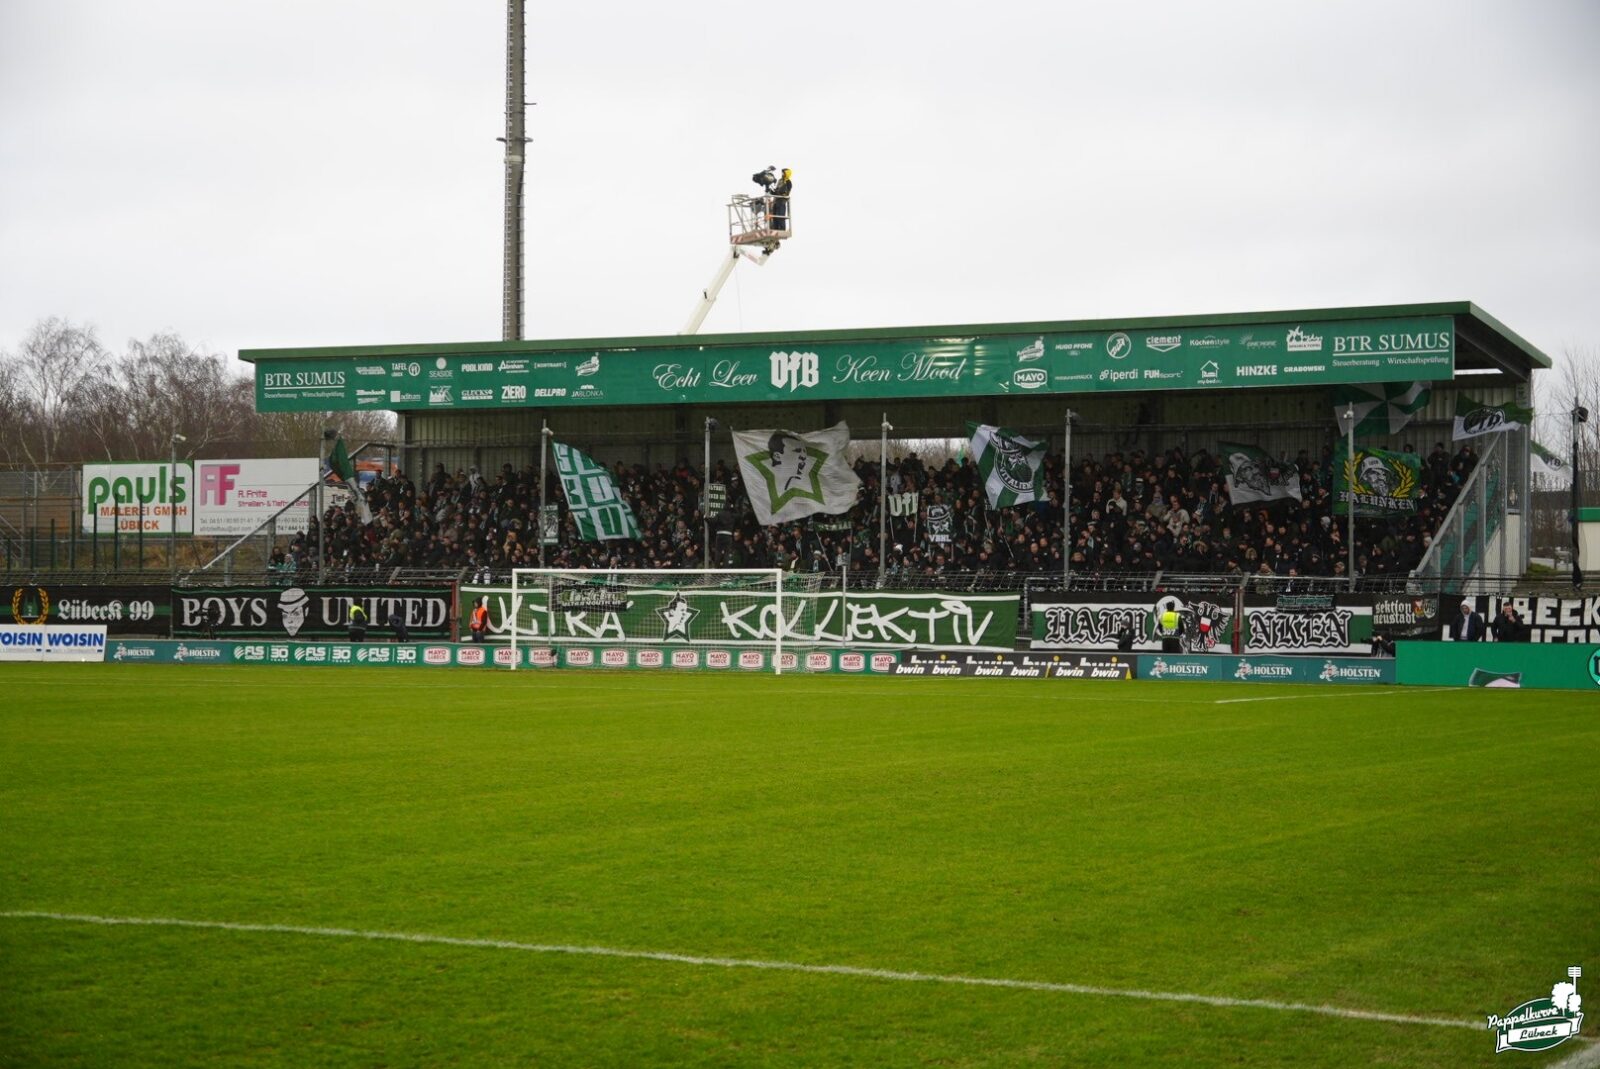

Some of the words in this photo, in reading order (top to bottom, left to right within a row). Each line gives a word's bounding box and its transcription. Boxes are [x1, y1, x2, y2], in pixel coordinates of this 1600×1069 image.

[1333, 336, 1371, 352] BTR
[1378, 332, 1450, 350] SUMUS
[833, 354, 891, 383] Keen
[897, 352, 967, 382] Mood
[1237, 365, 1277, 376] HINZKE
[264, 373, 292, 387] BTR
[296, 371, 345, 386] SUMUS
[653, 363, 701, 390] Echt
[1017, 373, 1044, 382] MAYO
[1110, 368, 1138, 382] iperdi
[88, 466, 186, 515] pauls
[101, 507, 150, 516] MALEREI
[57, 599, 124, 621] Lübeck
[129, 600, 155, 621] 99
[181, 597, 268, 627] BOYS
[1375, 600, 1412, 614] sektion
[1373, 612, 1416, 625] neustadt
[0, 632, 43, 646] OISIN
[47, 633, 104, 647] WOISIN
[245, 646, 265, 656] FLS
[271, 648, 289, 659] 30
[305, 647, 326, 657] FLS
[332, 649, 351, 660] 30
[369, 648, 390, 658] FLS
[397, 650, 416, 660] 30
[896, 664, 925, 674] bwin
[932, 664, 961, 674] bwin
[975, 666, 1003, 676] bwin
[1011, 666, 1039, 676] bwin
[1056, 667, 1084, 676] bwin
[1091, 667, 1119, 678] bwin
[1169, 665, 1208, 674] HOLSTEN
[1254, 666, 1292, 675] HOLSTEN
[1340, 668, 1380, 677] HOLSTEN
